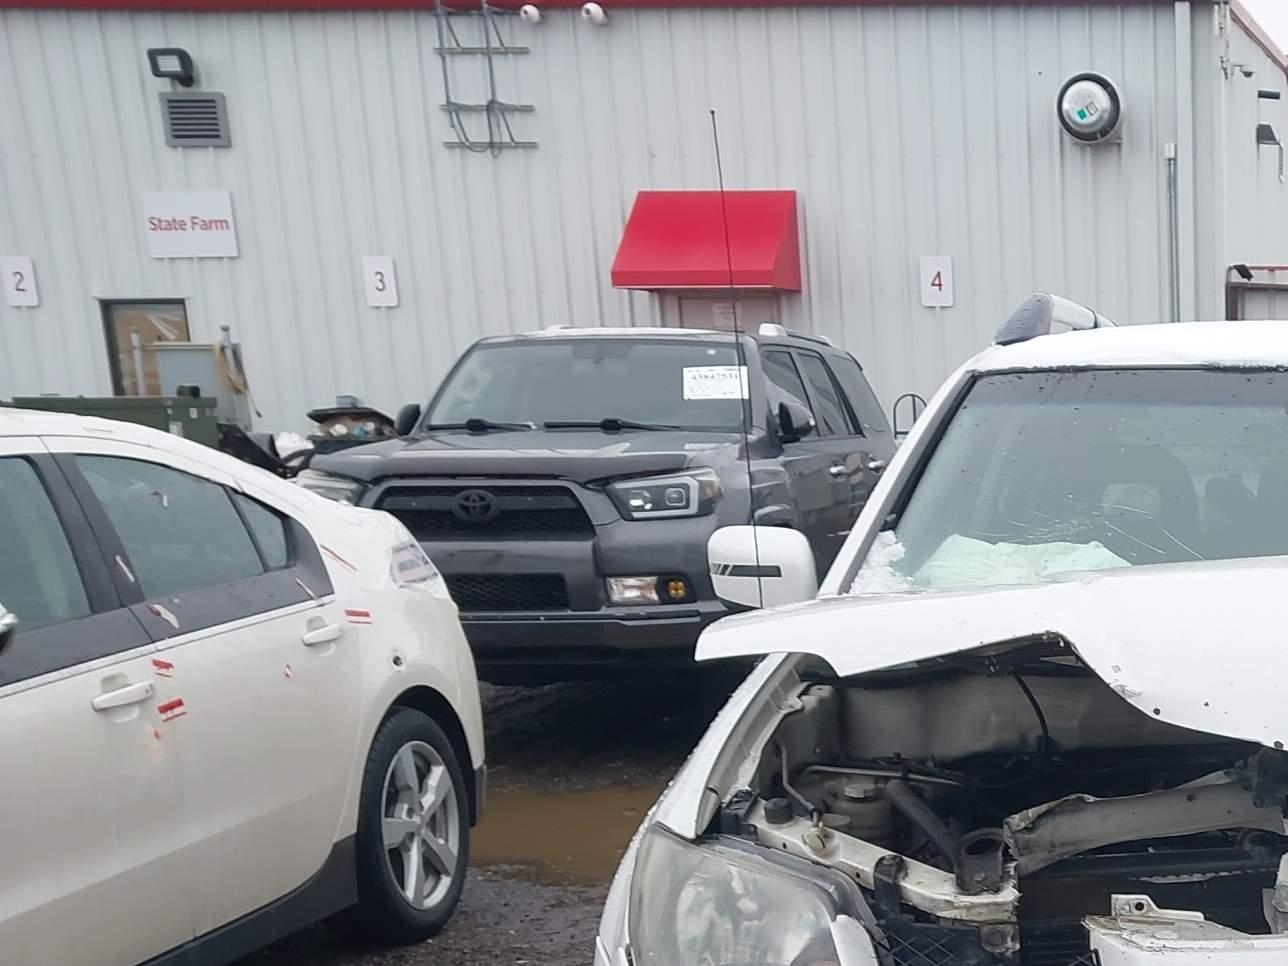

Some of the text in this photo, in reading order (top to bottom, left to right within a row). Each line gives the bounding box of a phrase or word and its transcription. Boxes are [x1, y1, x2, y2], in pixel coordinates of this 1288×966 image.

[148, 216, 230, 231] State Farm
[12, 271, 27, 292] 2
[374, 271, 386, 292] 3
[930, 270, 944, 292] 4
